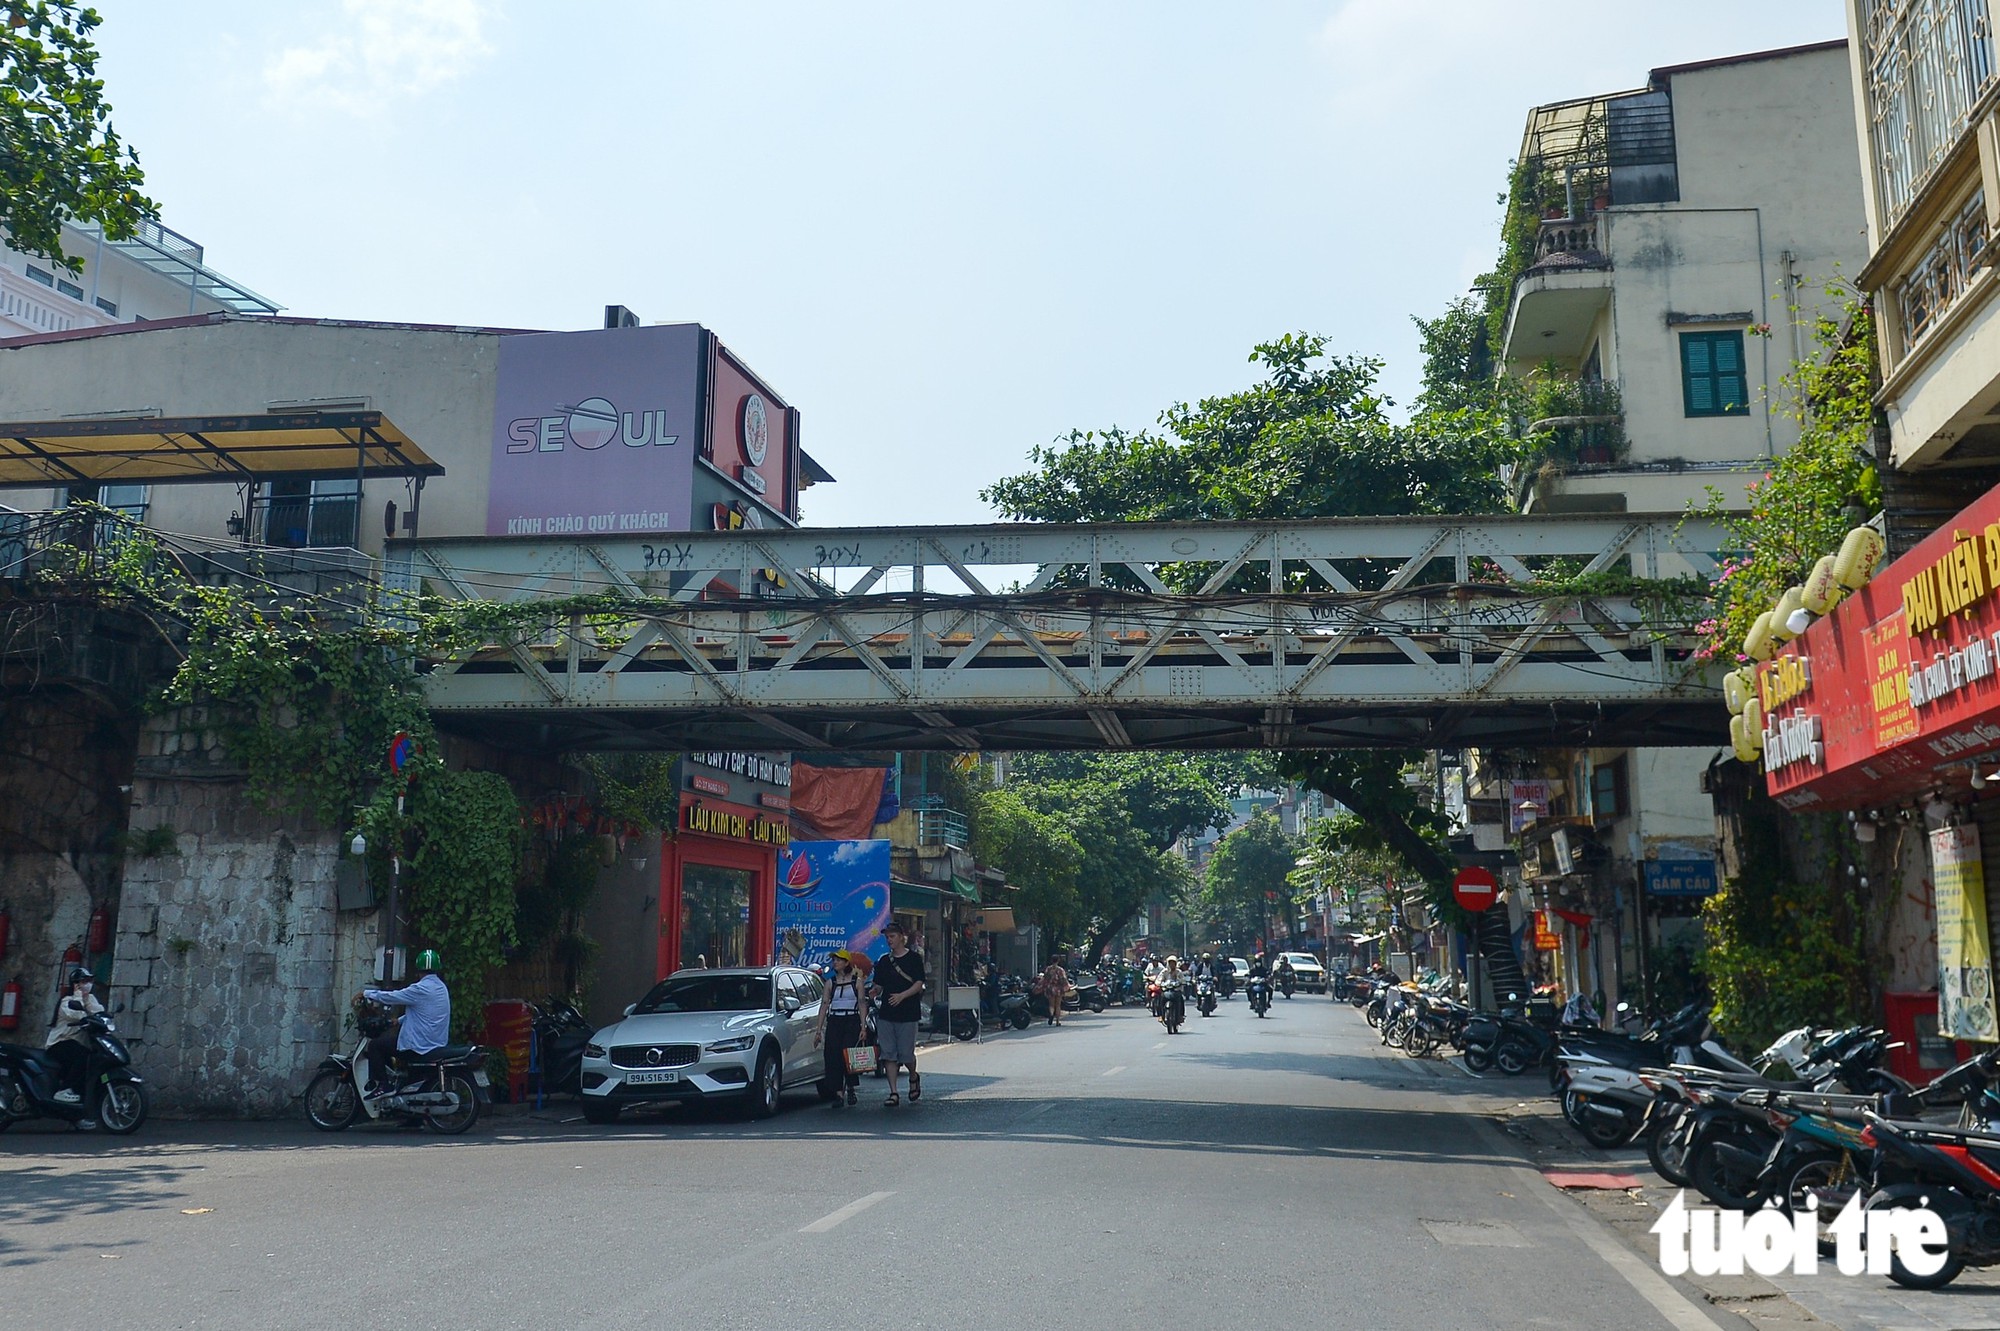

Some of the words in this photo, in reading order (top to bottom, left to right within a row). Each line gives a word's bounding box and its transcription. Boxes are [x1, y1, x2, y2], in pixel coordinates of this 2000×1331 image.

[506, 397, 679, 454] SEOUL
[508, 514, 542, 535] KÍNH
[545, 512, 583, 533] CHÀO
[588, 511, 615, 532] QUÝ
[620, 509, 669, 530] KHÁCH
[1902, 566, 1937, 640] PHỤ
[1937, 529, 1984, 621] KIỆN
[1949, 645, 1963, 689] ÉP
[1962, 635, 1988, 683] KÍNH
[1872, 676, 1897, 712] VÀNG
[689, 800, 709, 832] LẨU
[711, 809, 729, 835] KIM
[731, 815, 746, 838] CHI
[753, 813, 770, 842] LẨU
[808, 936, 848, 950] journey
[819, 925, 846, 935] stars
[630, 1073, 675, 1083] 99A-516.99
